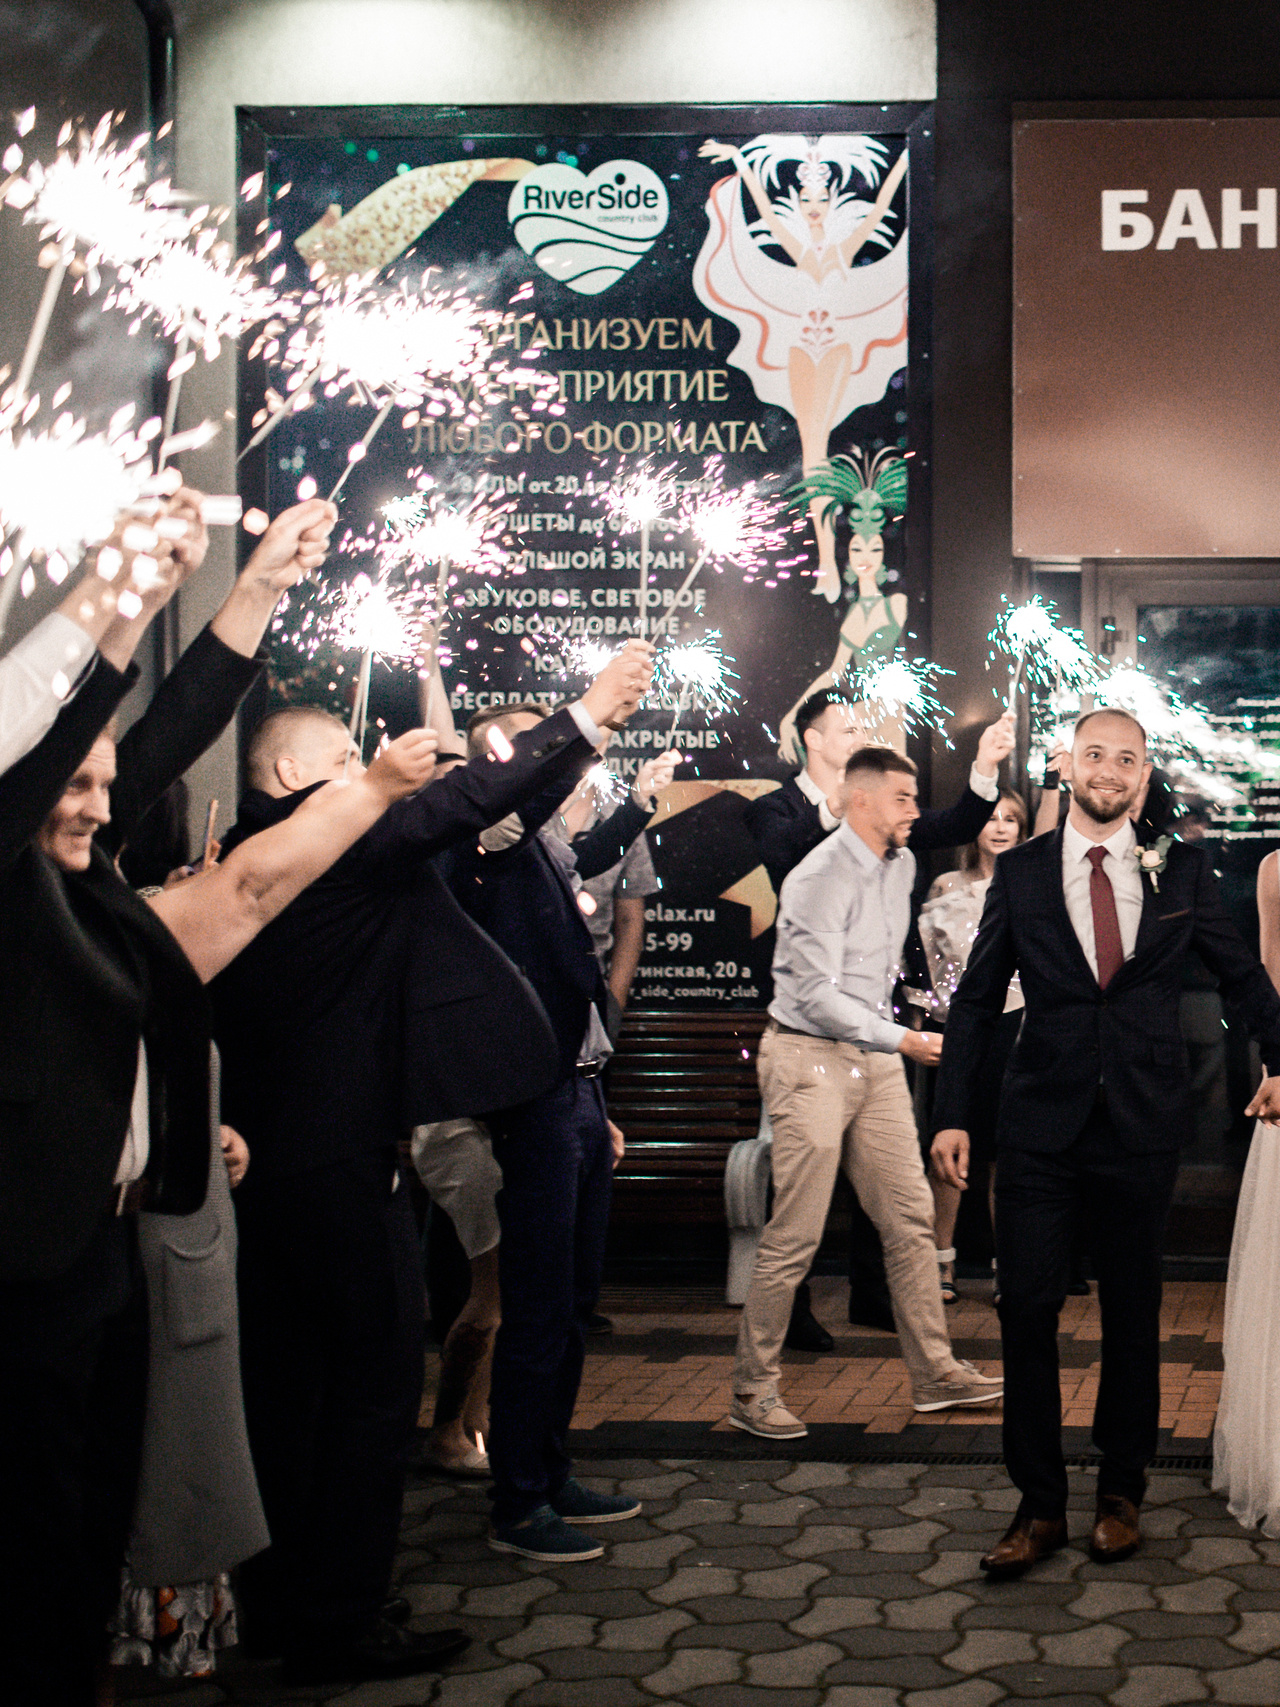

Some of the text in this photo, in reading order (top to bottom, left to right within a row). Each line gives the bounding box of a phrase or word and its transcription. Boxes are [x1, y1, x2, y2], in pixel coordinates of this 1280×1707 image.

[524, 174, 659, 210] RiverSide
[479, 318, 715, 350] РГАНИЗУЕМ
[411, 420, 768, 454] ЛЮБОГО ФОРМАТА
[528, 480, 551, 494] от
[555, 474, 579, 494] 20
[578, 518, 604, 534] до
[505, 547, 685, 570] ОЛЬШОЙ ЭКРАН
[464, 588, 706, 610] ЗВУКОВОЕ, СВЕТОВОЕ
[494, 615, 680, 636] ОБОРУДОВАНИЕ
[607, 729, 718, 749] АКРЫТЫЕ
[644, 903, 715, 922] elax.ru
[645, 932, 693, 951] 5-99
[714, 961, 737, 978] 20
[629, 985, 760, 1000] r_side_country_club
